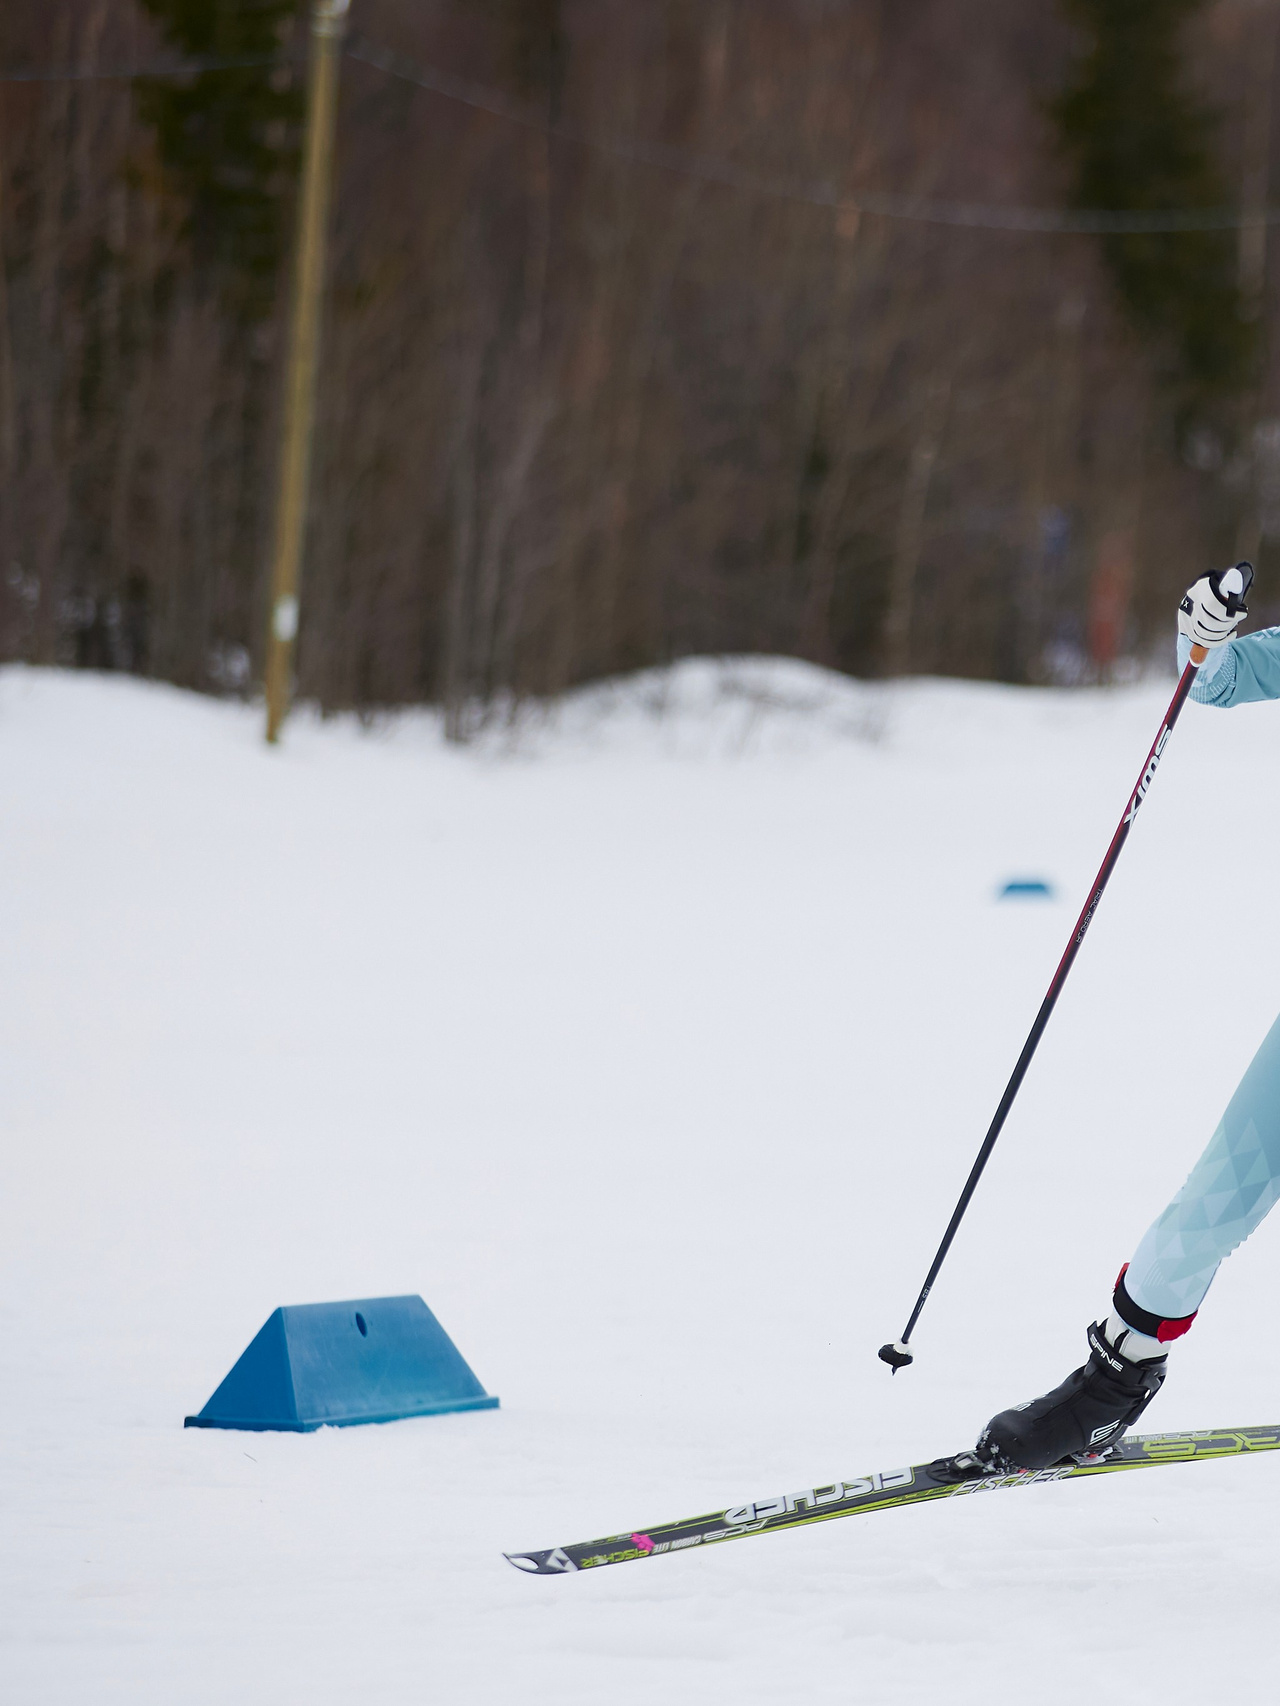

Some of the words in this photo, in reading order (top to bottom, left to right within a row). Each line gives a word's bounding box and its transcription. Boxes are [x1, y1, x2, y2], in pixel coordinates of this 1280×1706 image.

[1090, 1333, 1124, 1372] SPINE
[724, 1466, 913, 1526] FISCHER
[949, 1466, 1076, 1497] FISCHER
